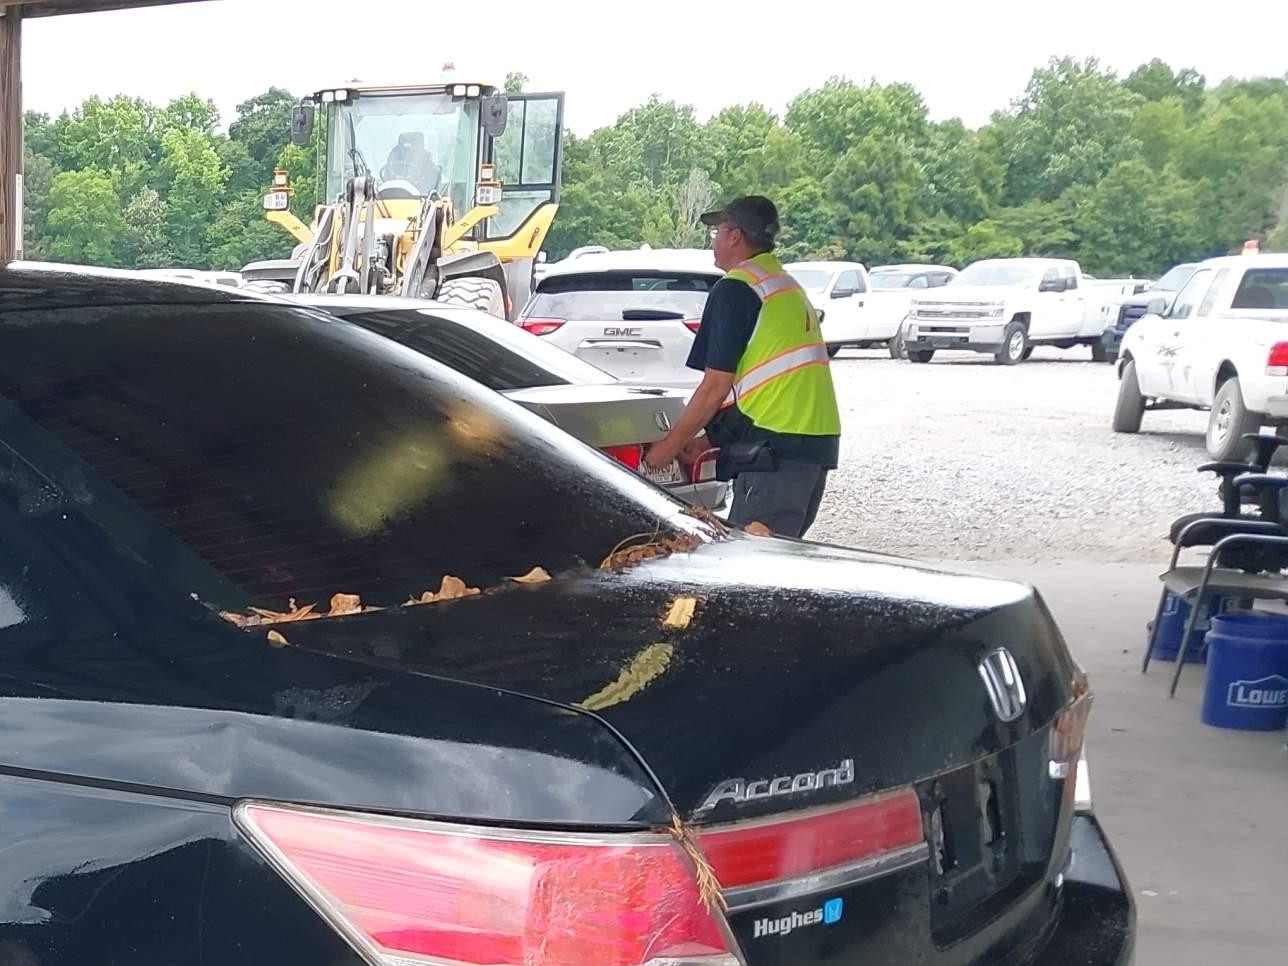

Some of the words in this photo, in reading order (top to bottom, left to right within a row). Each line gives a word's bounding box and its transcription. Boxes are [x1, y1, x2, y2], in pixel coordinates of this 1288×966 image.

[603, 327, 642, 337] GMC
[692, 758, 855, 820] Accord
[753, 907, 823, 938] Hughes
